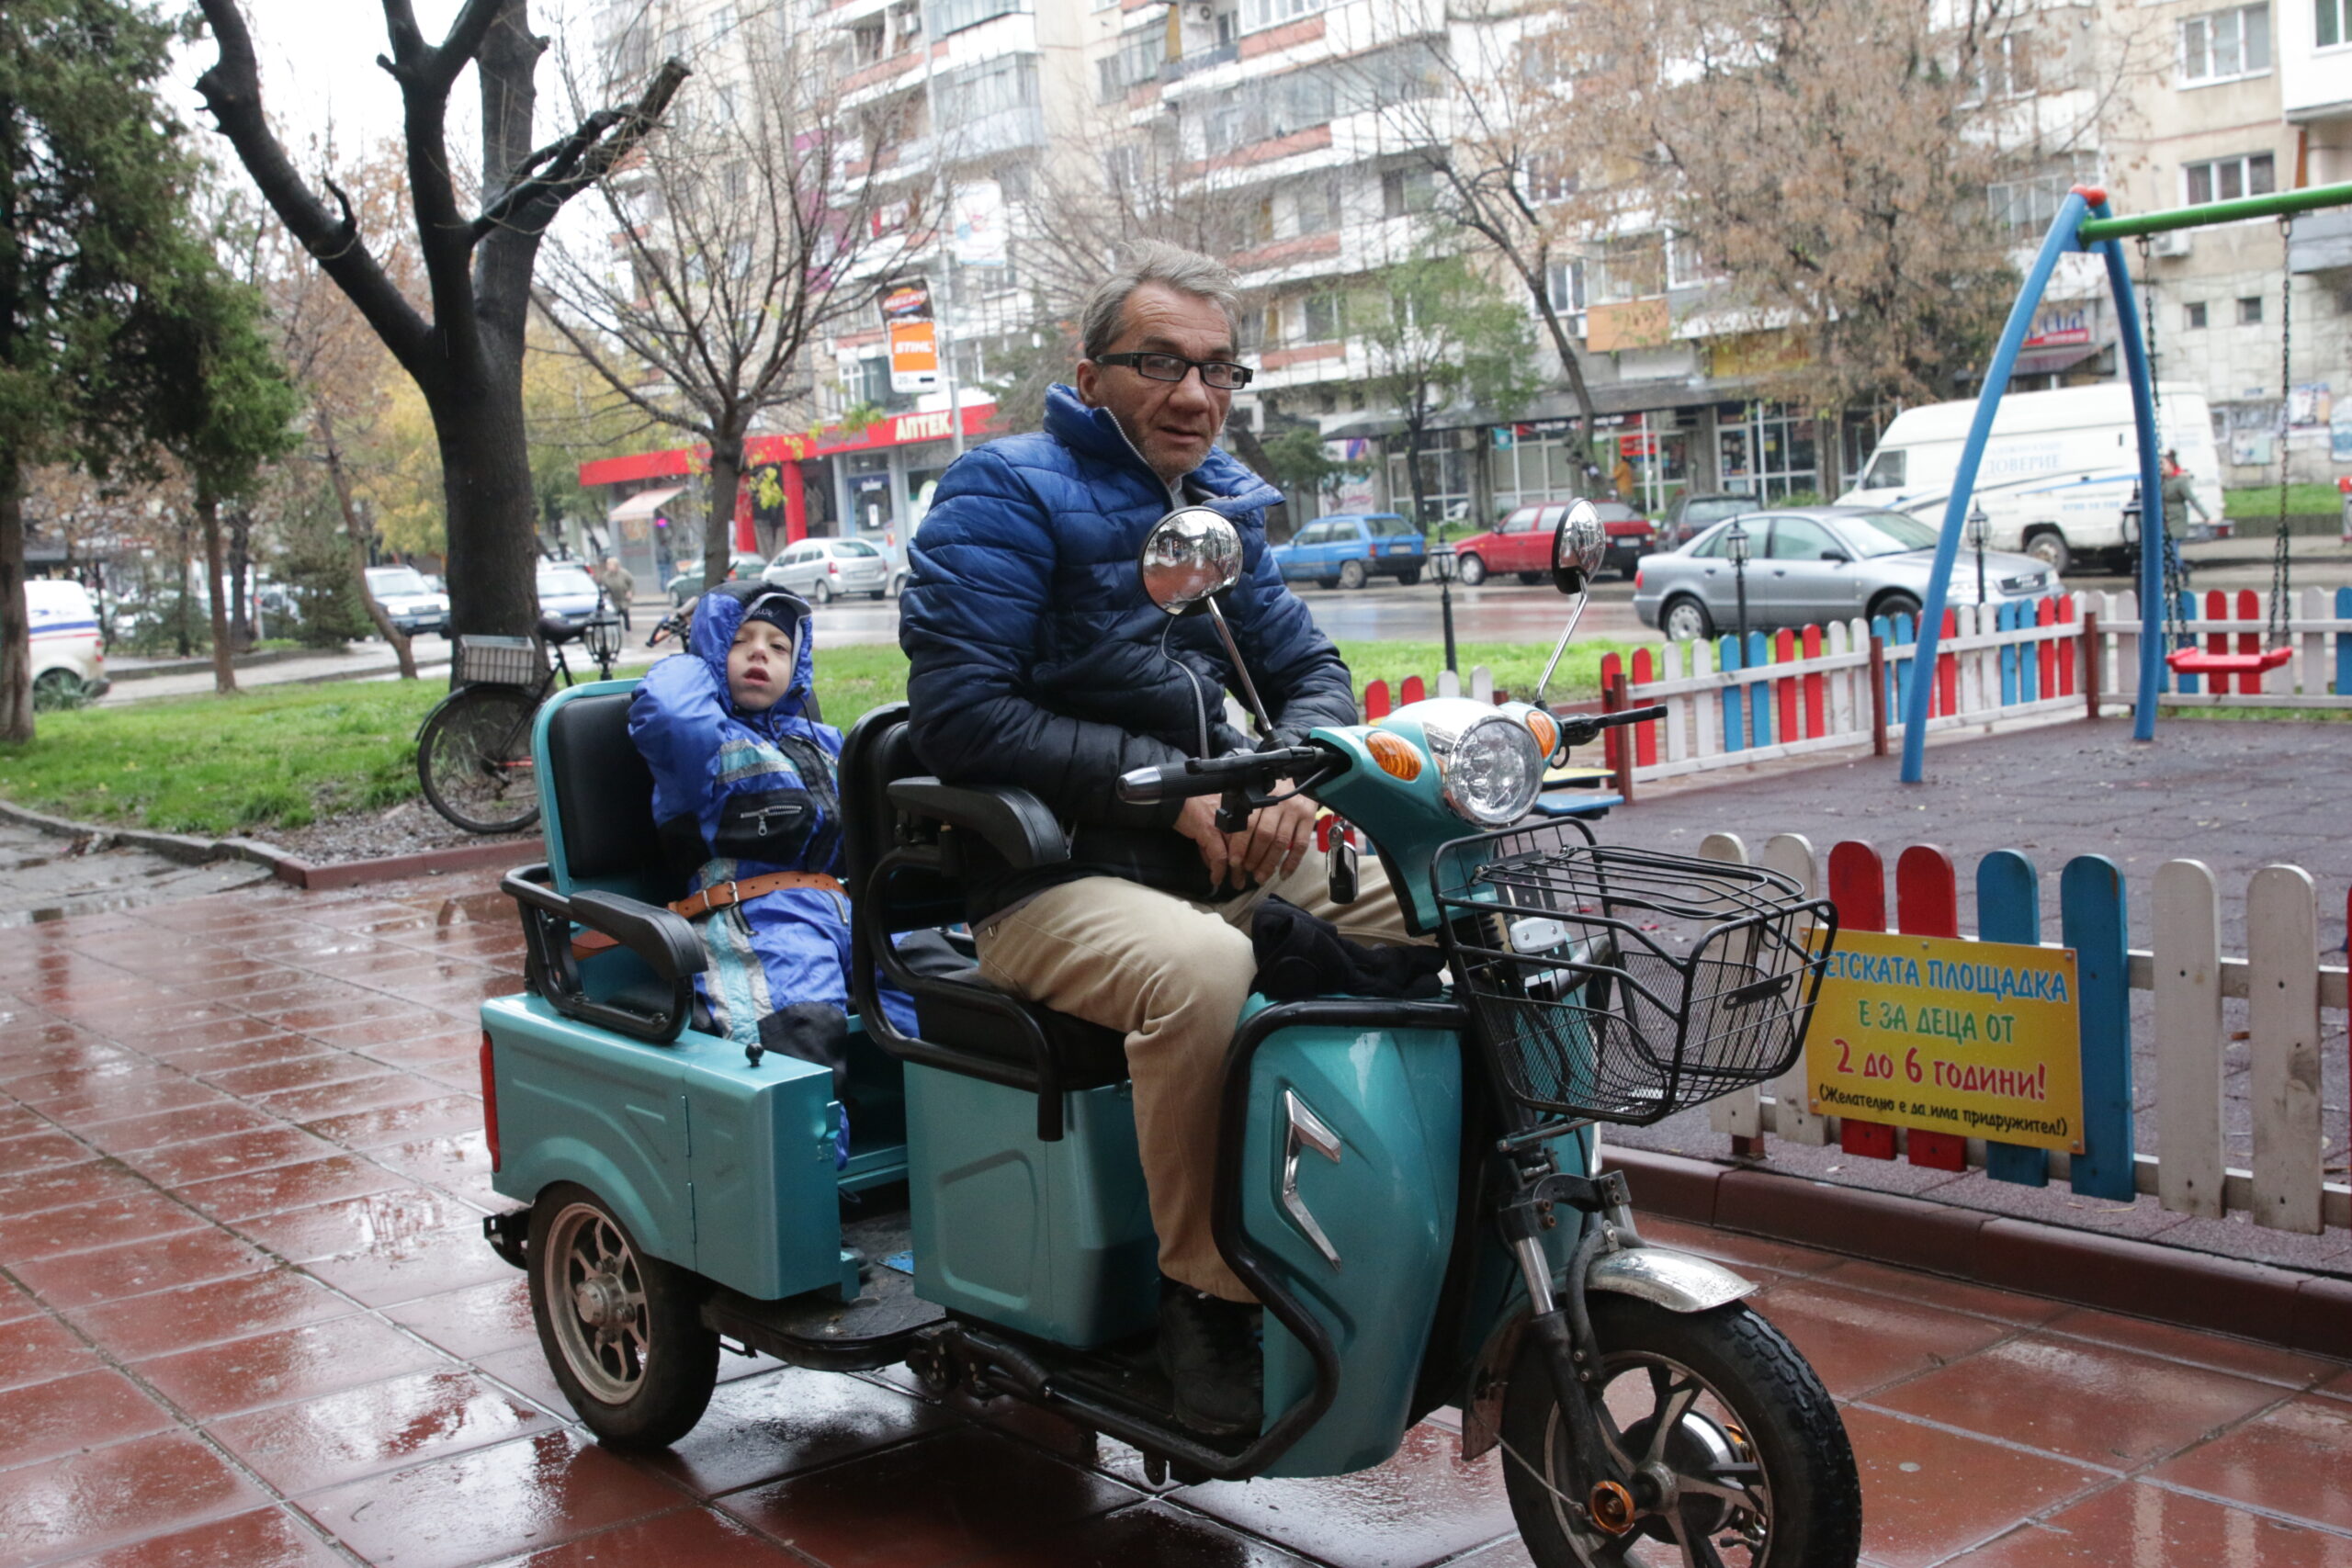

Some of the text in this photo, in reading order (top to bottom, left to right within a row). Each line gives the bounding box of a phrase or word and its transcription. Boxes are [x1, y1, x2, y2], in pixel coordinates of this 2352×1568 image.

[895, 341, 933, 354] STIHL
[895, 412, 962, 442] АПТЕК
[1983, 455, 2059, 478] ДОВЕРИЕ
[1927, 959, 2069, 1003] ПЛОЩАДКА
[1858, 999, 2015, 1045] Е ЗА ДЕЦА ОТ
[1833, 1038, 1854, 1074] 2
[1905, 1046, 1923, 1083] 6
[1819, 1083, 2068, 1137] (Желателно е да има придружител!)
